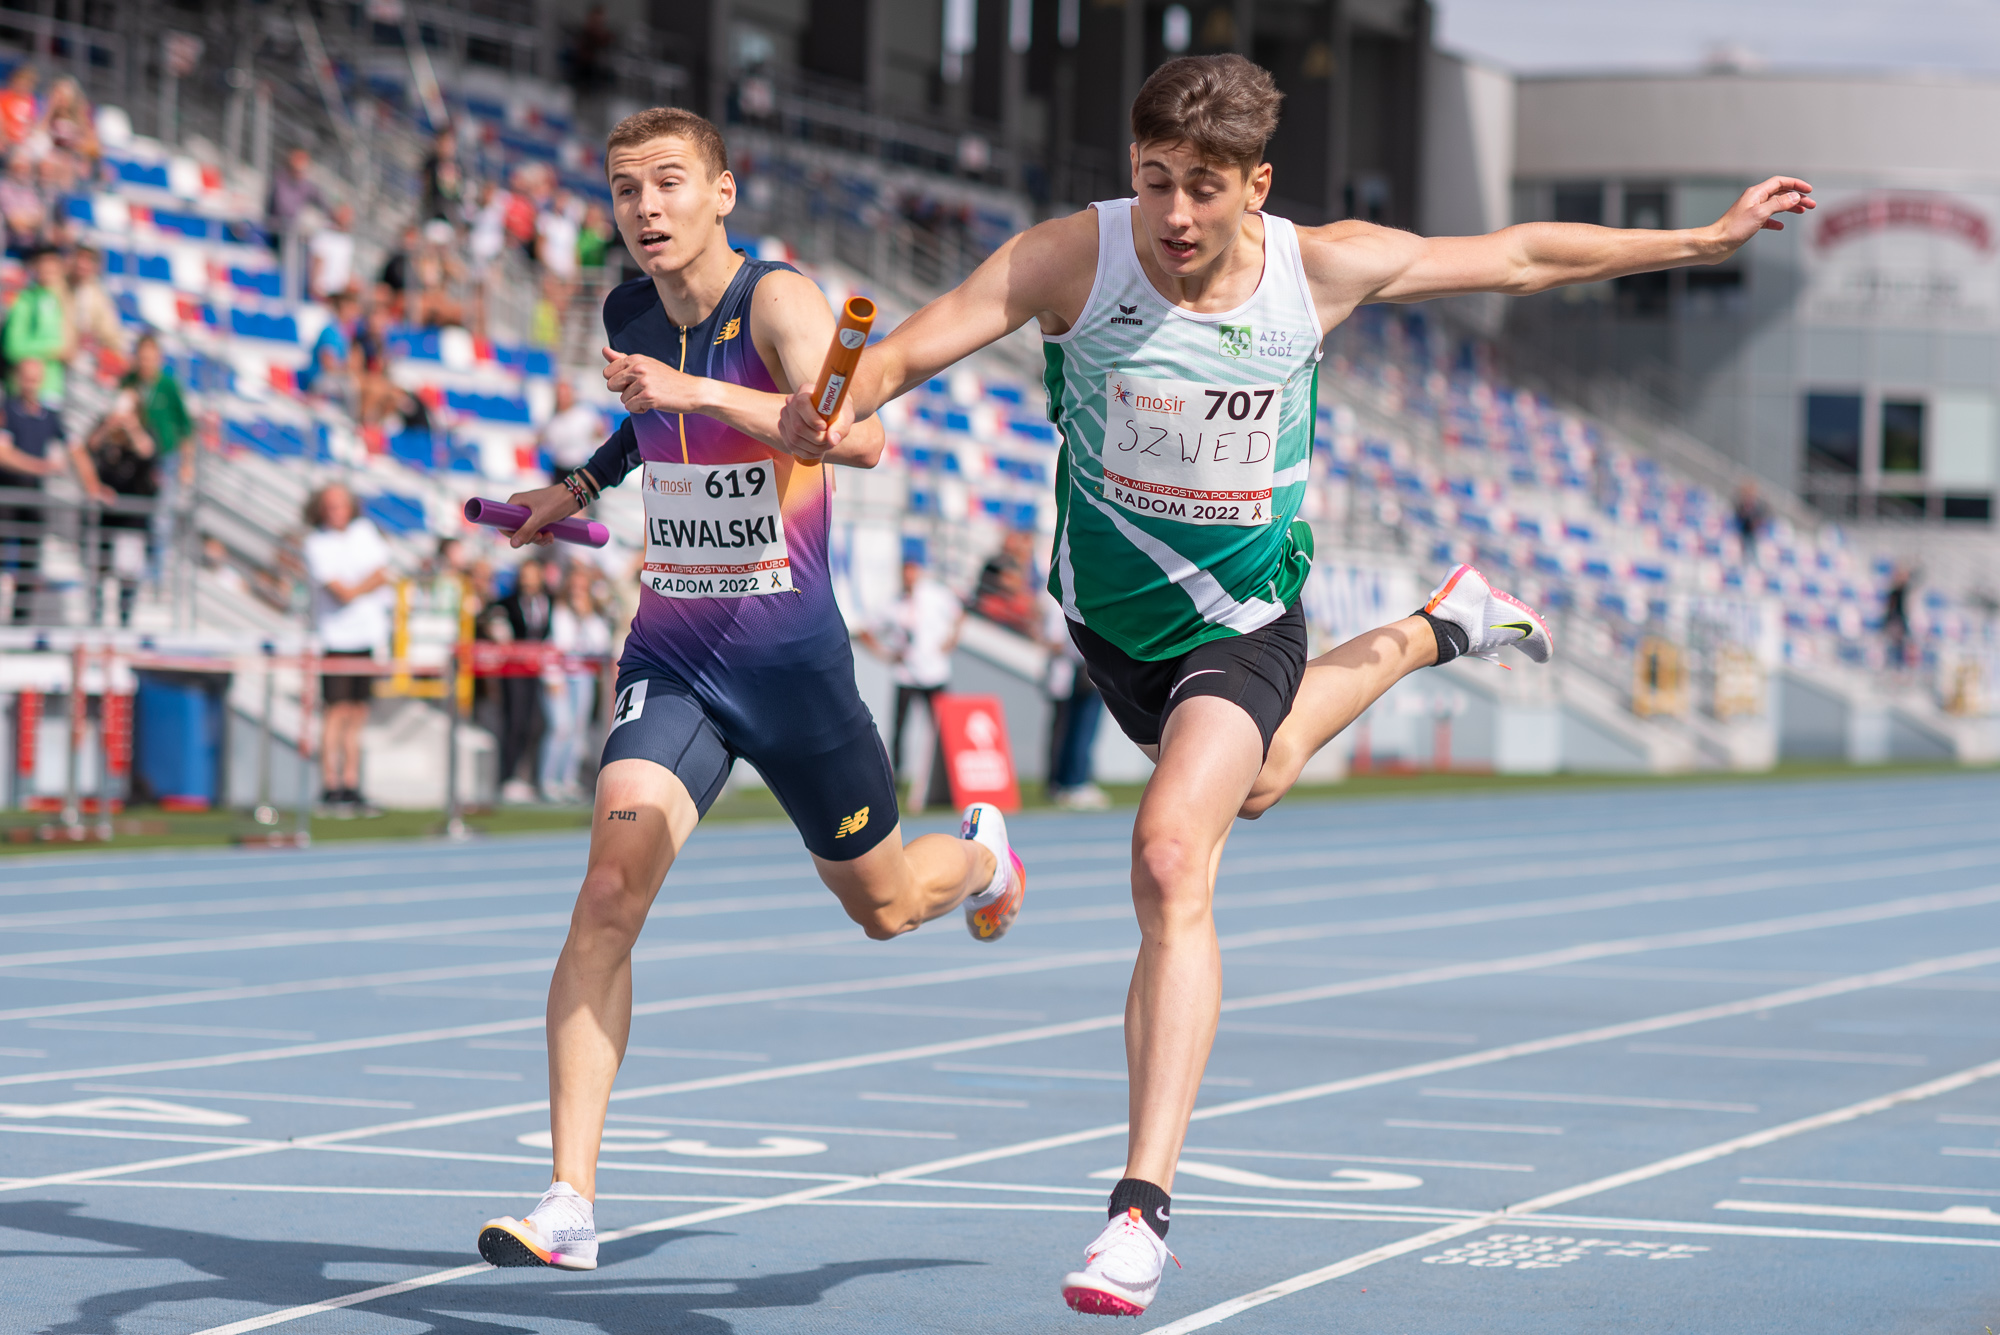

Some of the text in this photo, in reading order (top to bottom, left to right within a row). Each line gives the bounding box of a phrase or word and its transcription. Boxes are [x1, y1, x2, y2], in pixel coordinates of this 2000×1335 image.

[1110, 316, 1143, 326] erima
[1135, 395, 1186, 412] mosir
[1204, 389, 1275, 421] 707
[1118, 419, 1271, 464] SZWED
[660, 478, 692, 493] mosir
[705, 467, 766, 499] 619
[1106, 470, 1270, 500] PZLA MISTRZOSTWA POLSKI U20
[1115, 487, 1240, 520] RADOM 2022
[650, 515, 777, 548] LEWALSKI
[646, 559, 786, 574] PZLA MISTRZOSTWA POLSKI U20
[652, 577, 759, 593] RADOM 2022
[615, 686, 634, 722] 4
[608, 810, 637, 821] run
[835, 806, 870, 839] NB
[517, 1129, 828, 1158] 3
[1087, 1160, 1424, 1191] 2
